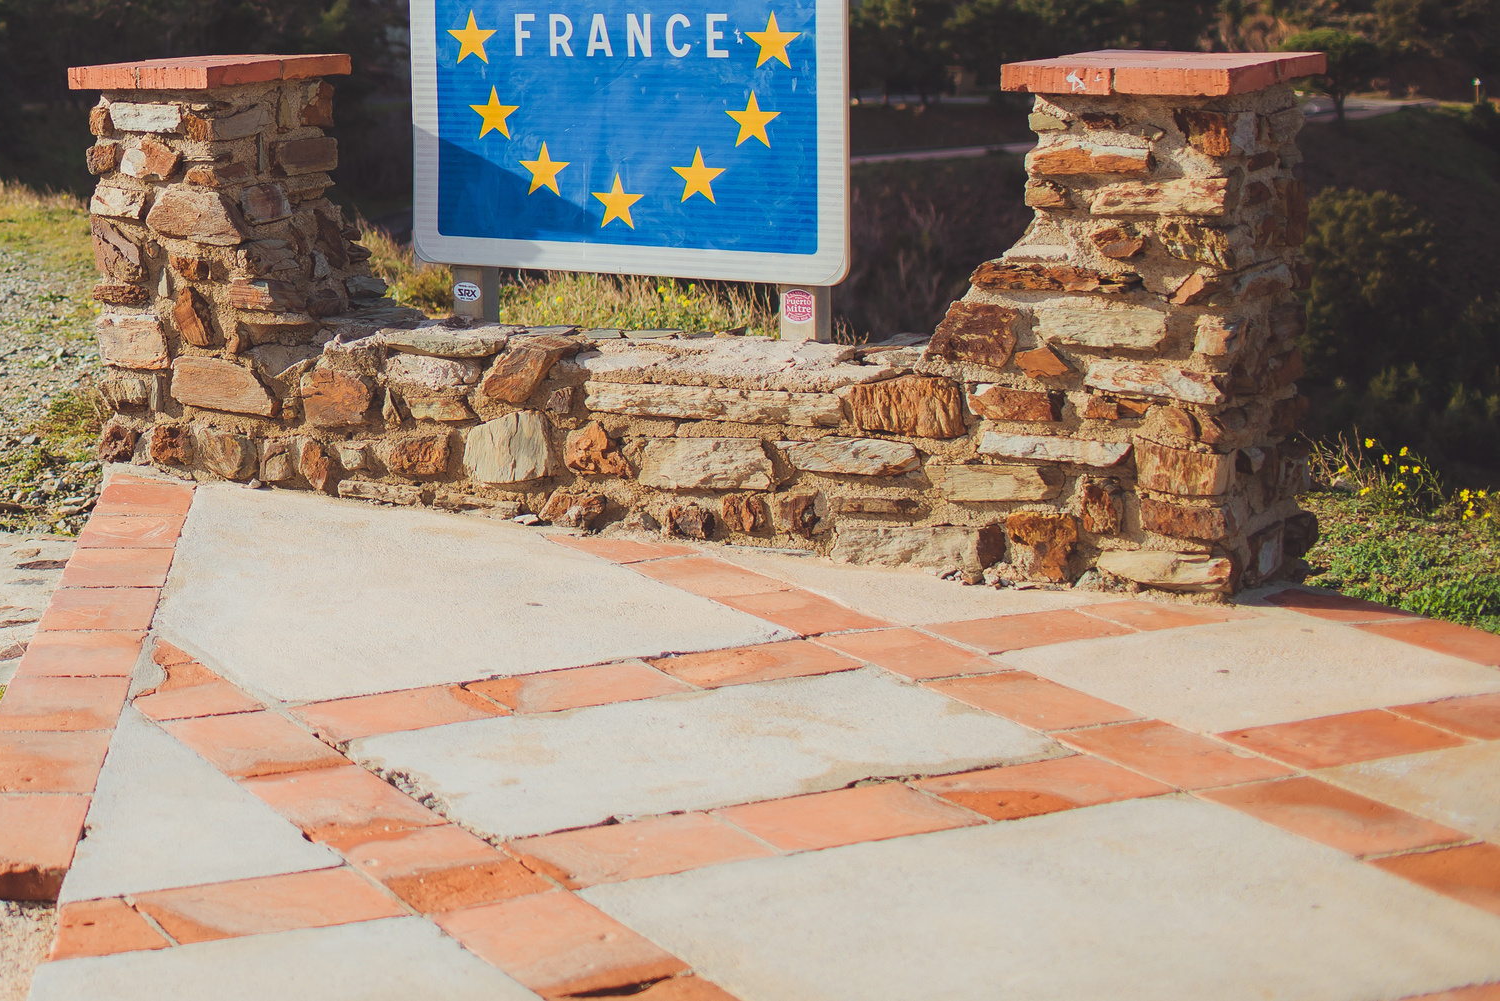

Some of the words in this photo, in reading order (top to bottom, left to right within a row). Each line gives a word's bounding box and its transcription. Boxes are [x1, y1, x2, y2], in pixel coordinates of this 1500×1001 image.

[514, 13, 730, 58] FRANCE
[457, 288, 477, 298] SRX
[786, 298, 812, 306] Puerto
[786, 304, 812, 313] Mitre
